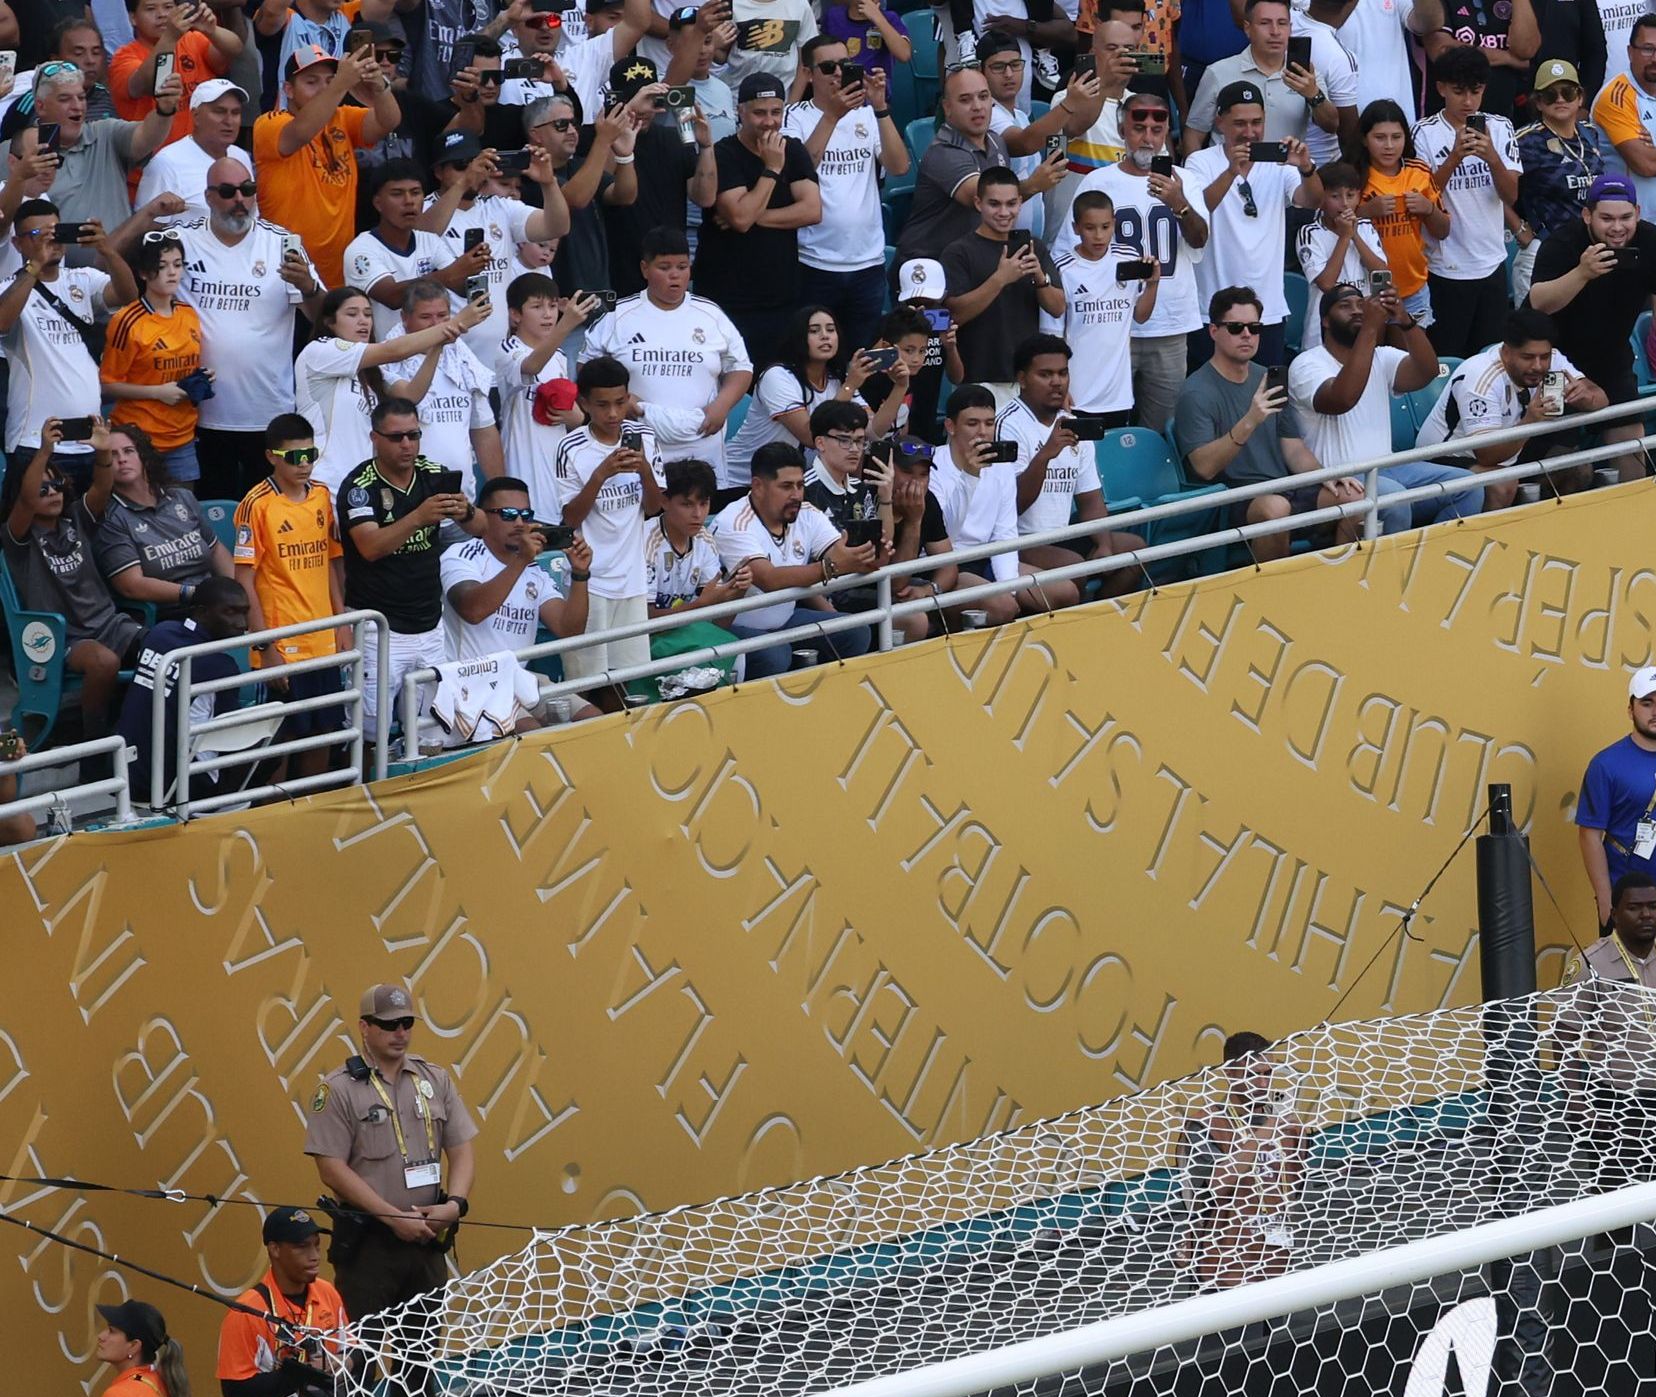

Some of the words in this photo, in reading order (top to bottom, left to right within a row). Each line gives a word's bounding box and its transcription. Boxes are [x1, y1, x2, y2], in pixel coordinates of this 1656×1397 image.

[190, 277, 262, 298] Emirates
[199, 297, 215, 309] FLY
[217, 298, 250, 312] BETTER
[1074, 298, 1130, 314] Emirates
[1097, 311, 1123, 324] BETTER
[632, 347, 703, 363] Emirates
[642, 363, 658, 375] FLY
[660, 363, 692, 376] BETTER
[143, 530, 202, 563] Emirates
[278, 539, 328, 559] Emirates
[626, 702, 1024, 1155] INTERNACIO
